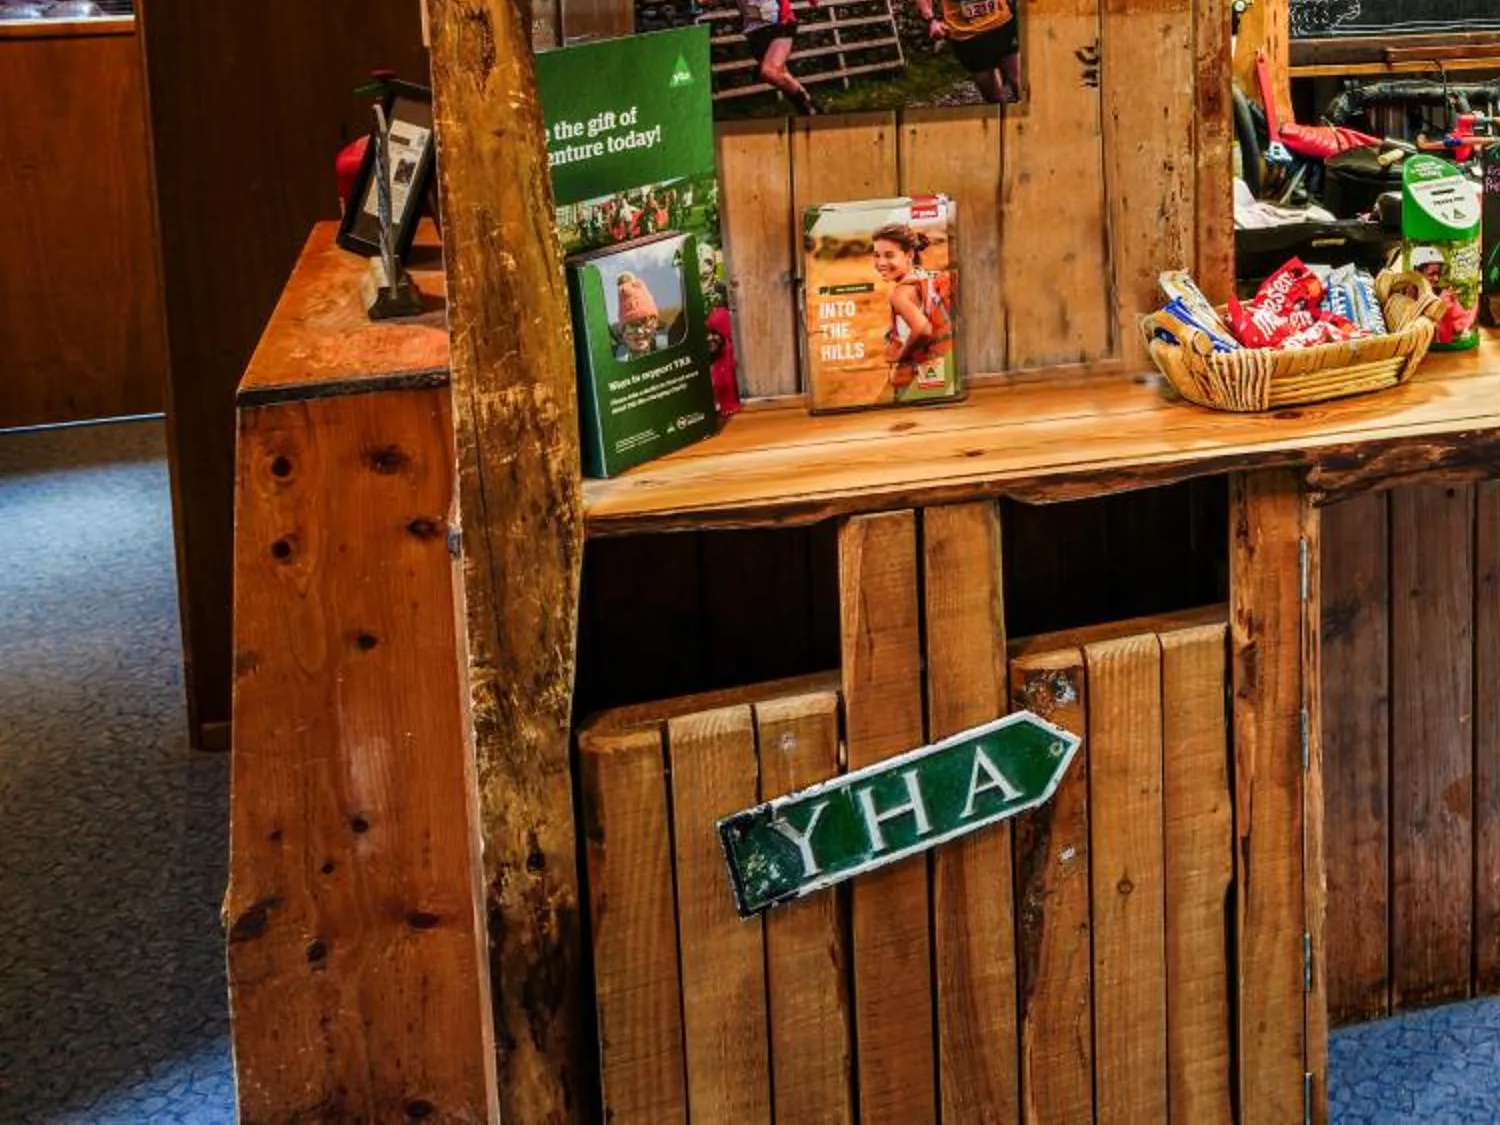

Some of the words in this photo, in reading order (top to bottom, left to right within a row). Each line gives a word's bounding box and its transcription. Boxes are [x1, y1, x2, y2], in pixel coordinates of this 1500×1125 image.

[553, 120, 584, 141] the
[587, 111, 617, 138] gift
[619, 106, 638, 126] of
[606, 124, 662, 153] today!
[818, 299, 857, 320] INTO
[819, 321, 852, 340] THE
[820, 342, 865, 363] HILLS
[766, 744, 1024, 878] YHA
